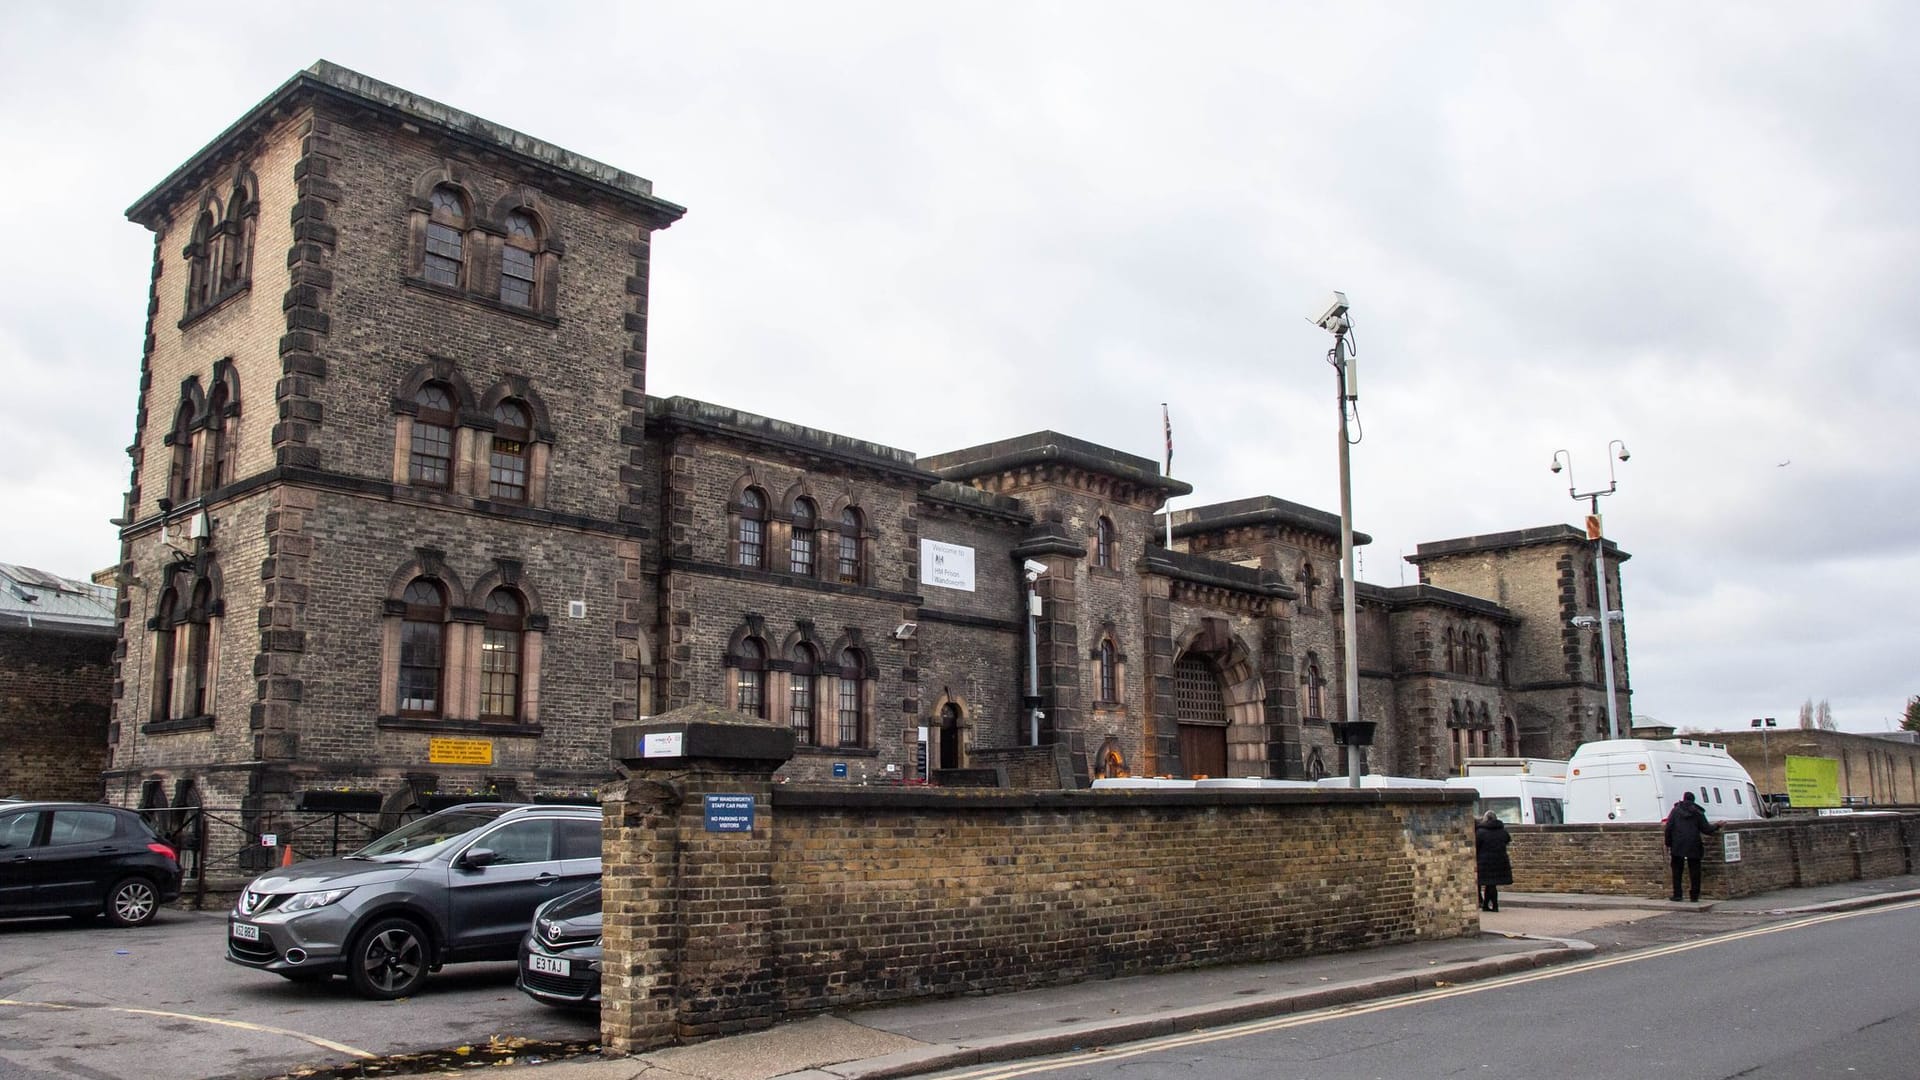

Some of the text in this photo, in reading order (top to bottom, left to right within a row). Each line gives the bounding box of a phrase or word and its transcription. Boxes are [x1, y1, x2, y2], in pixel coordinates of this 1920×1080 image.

[932, 543, 957, 555] Welcome
[944, 569, 960, 578] Prison
[536, 957, 562, 973] E3 TAJ
